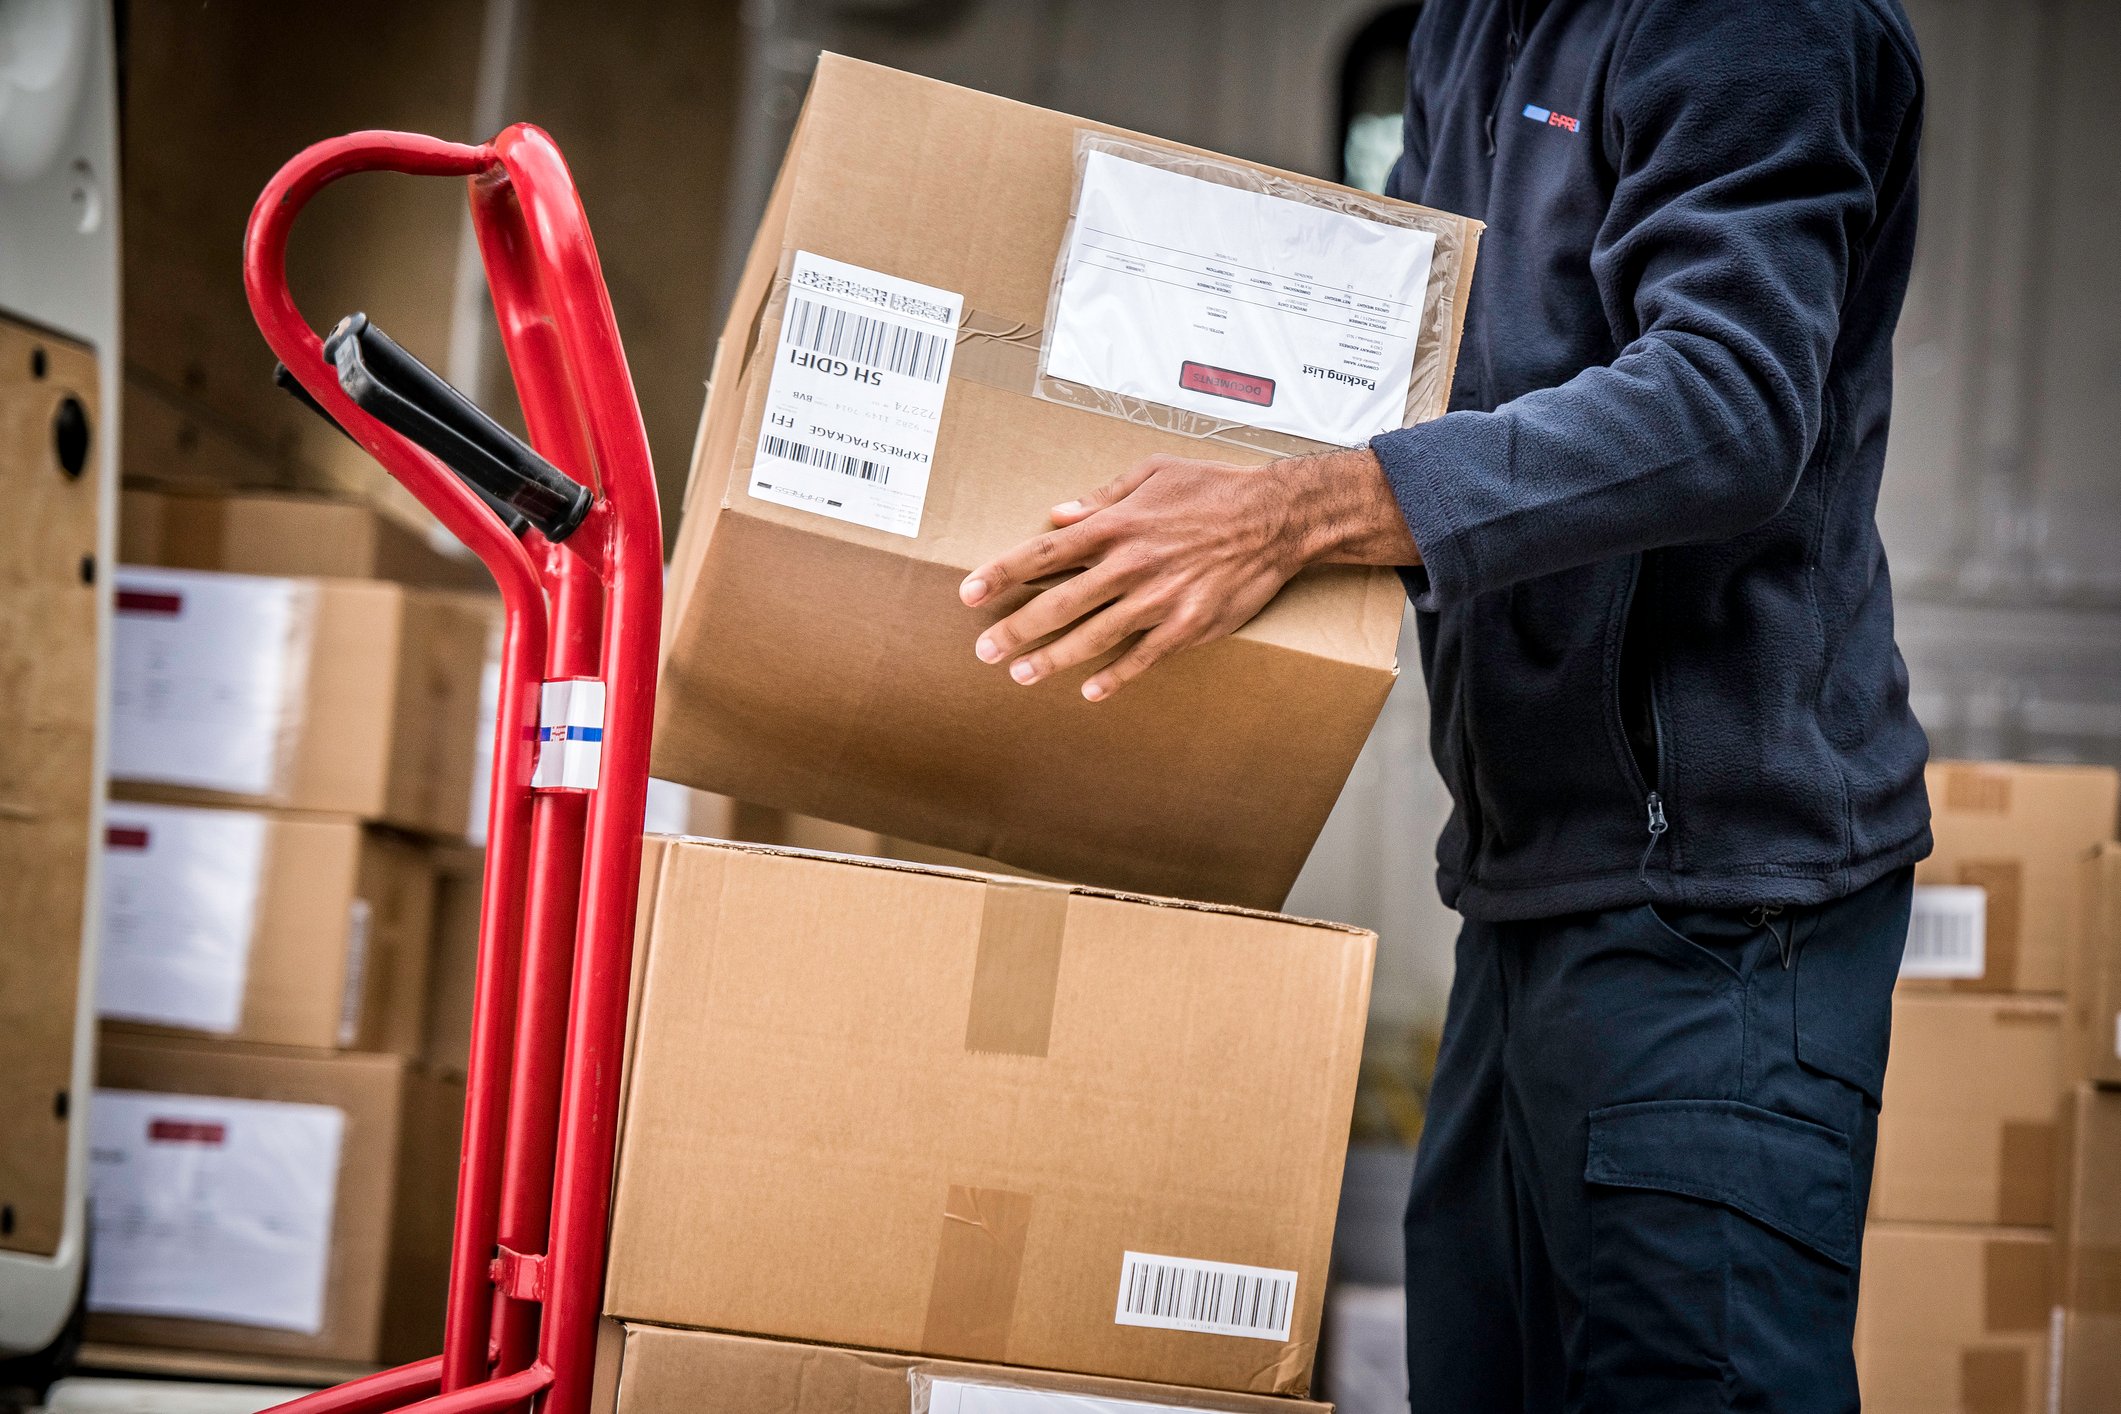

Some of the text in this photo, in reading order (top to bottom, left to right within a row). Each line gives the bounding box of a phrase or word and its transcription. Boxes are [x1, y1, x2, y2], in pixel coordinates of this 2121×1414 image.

[1205, 266, 1234, 276] DESCRIPTION
[1249, 277, 1272, 286] QUANTITY
[1282, 285, 1311, 295] DIMENSIONS
[1338, 342, 1381, 355] COMPANY ADDRESS
[791, 350, 883, 385] 5H GDIFI
[1192, 373, 1261, 395] DOCUMENTS
[1303, 366, 1375, 390] Packing List
[792, 390, 812, 402] BVB
[896, 402, 936, 419] 72274
[772, 413, 794, 428] FFI
[810, 426, 928, 462] EXPRESS PACKAGE
